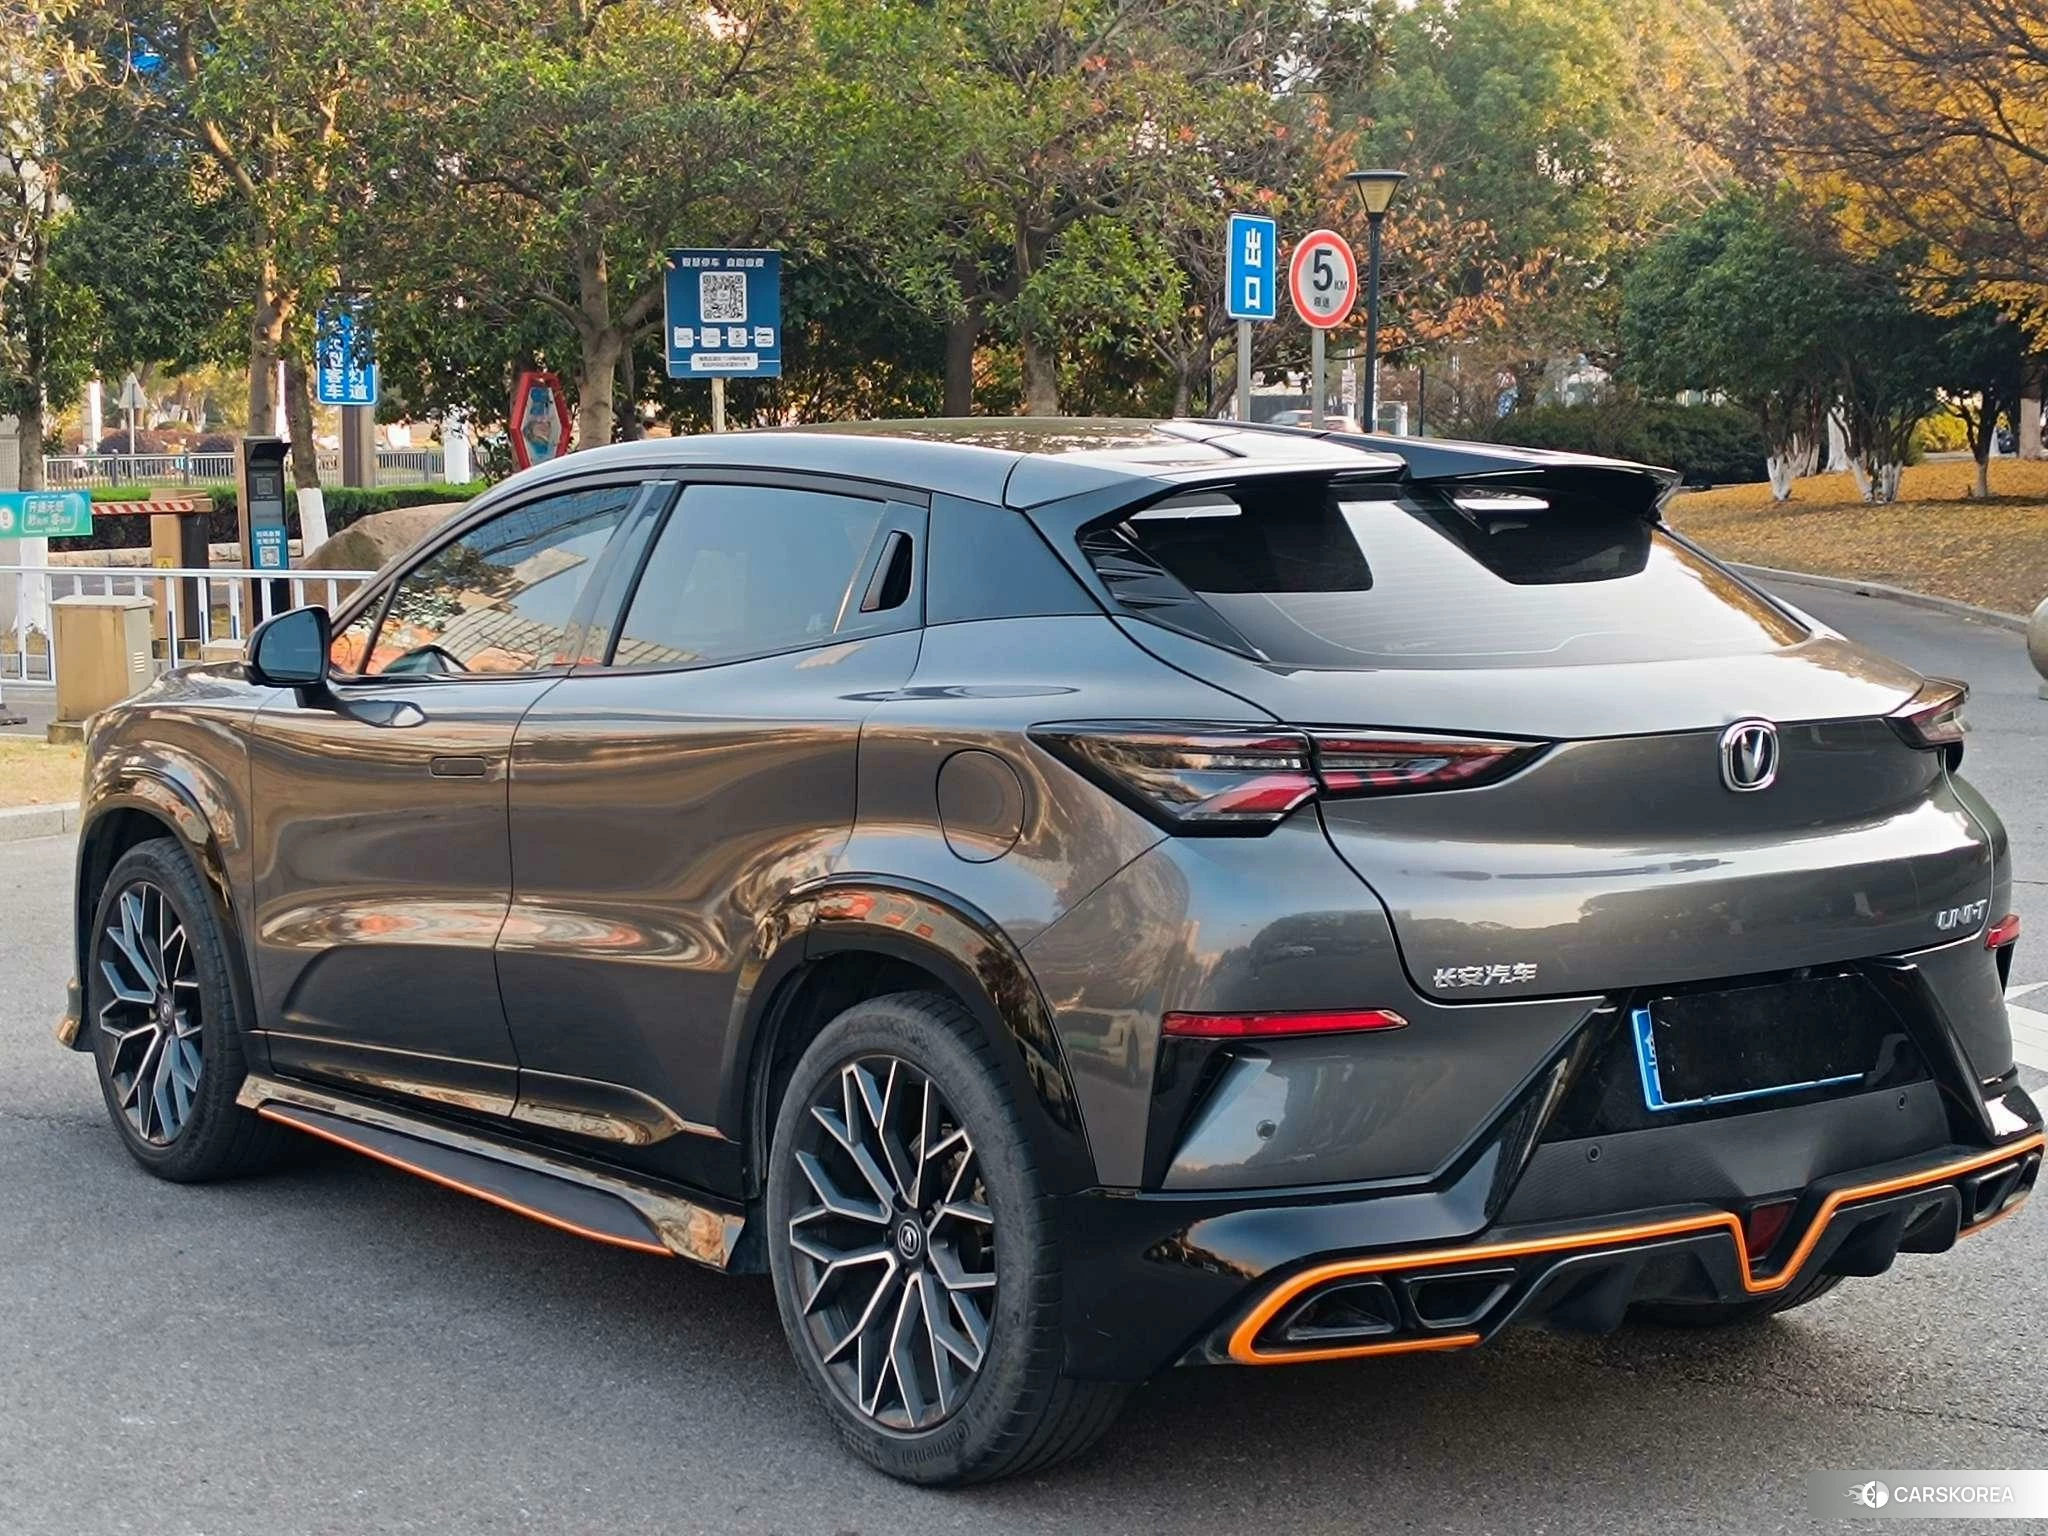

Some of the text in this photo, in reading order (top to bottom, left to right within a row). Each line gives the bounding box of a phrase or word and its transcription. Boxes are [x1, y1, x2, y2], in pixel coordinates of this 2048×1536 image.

[1245, 227, 1262, 309] 出口
[1313, 249, 1333, 291] 5
[1433, 963, 1537, 988] 长安汽车
